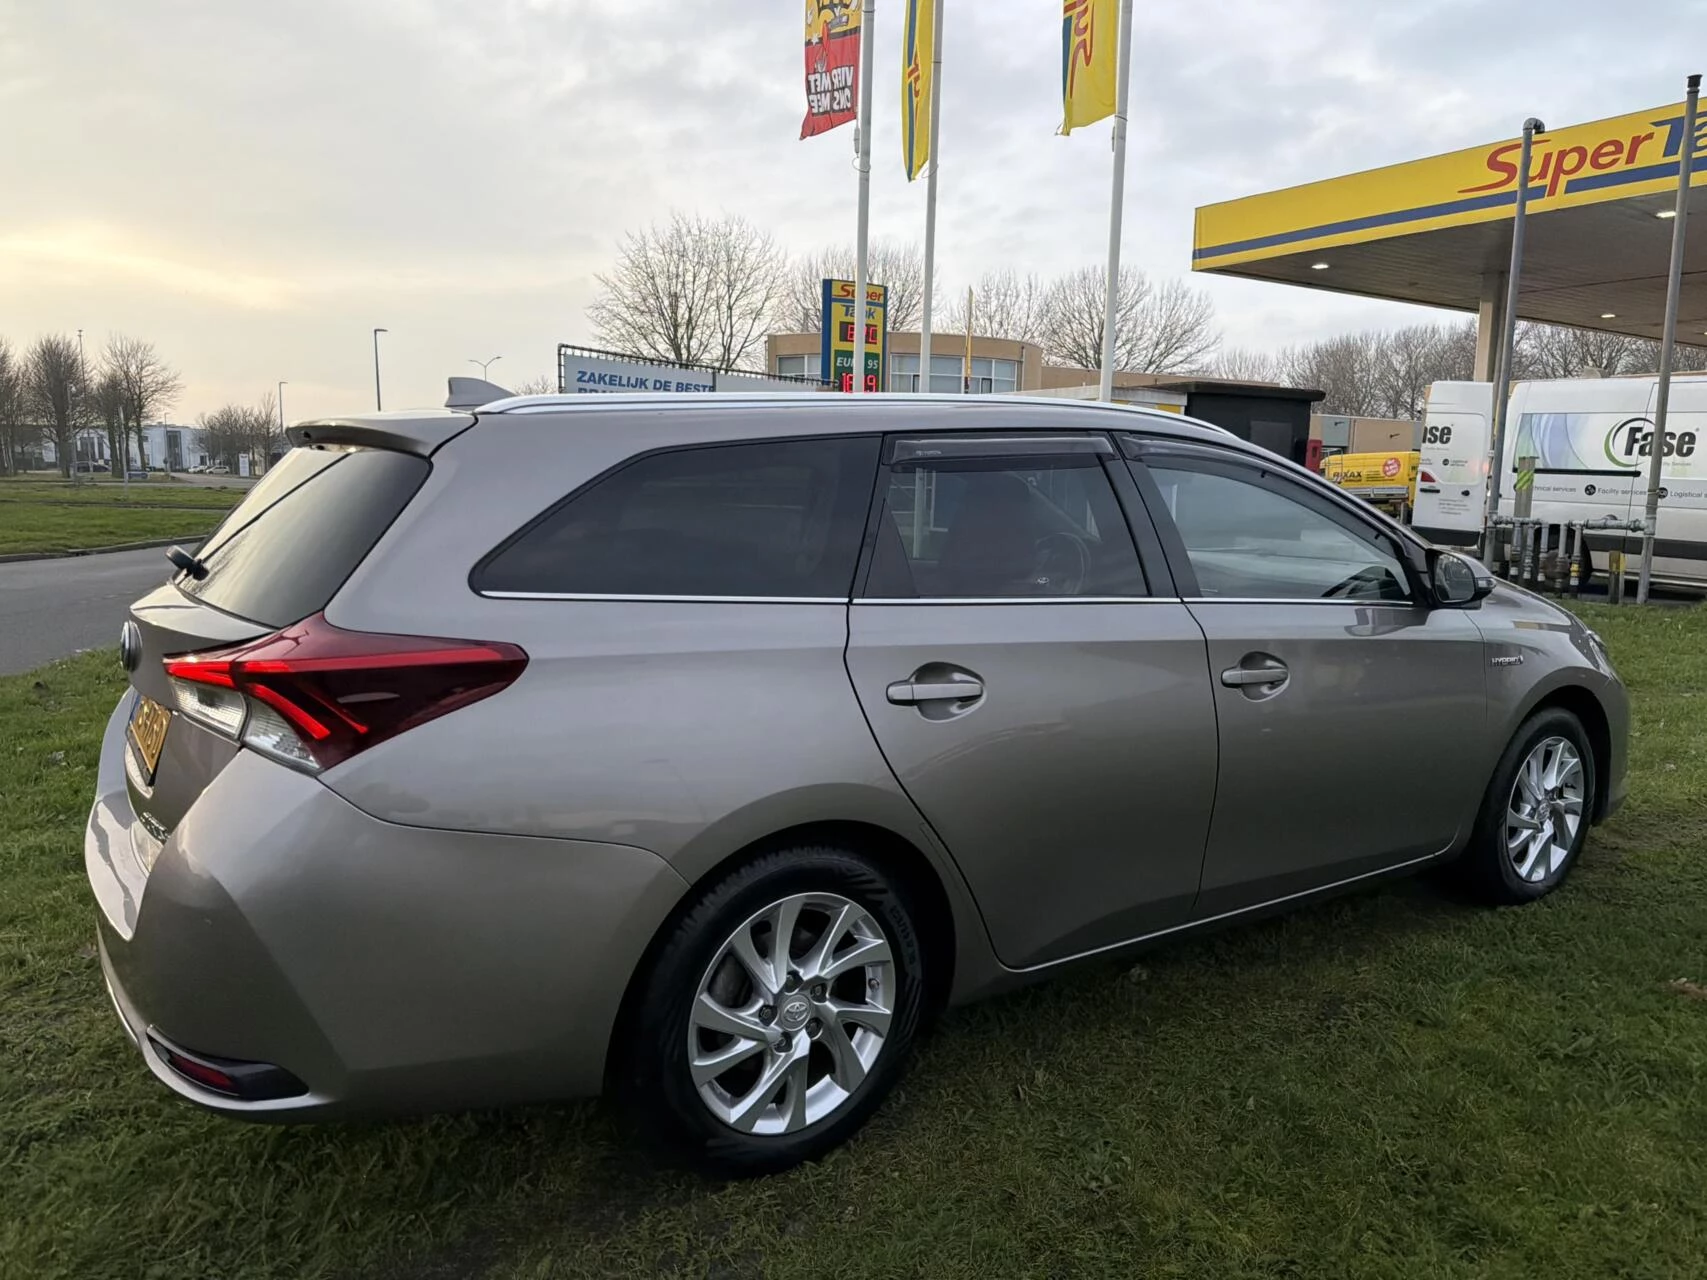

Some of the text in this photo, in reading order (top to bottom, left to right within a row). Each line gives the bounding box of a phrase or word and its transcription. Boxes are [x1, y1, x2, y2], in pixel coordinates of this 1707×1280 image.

[1457, 131, 1654, 197] Super
[832, 283, 884, 301] Suer
[841, 304, 876, 319] Tak
[867, 359, 878, 369] 95
[576, 370, 648, 390] ZAKELIJK
[653, 379, 672, 391] DE
[1624, 427, 1697, 457] Fase
[1597, 487, 1619, 495] Facility
